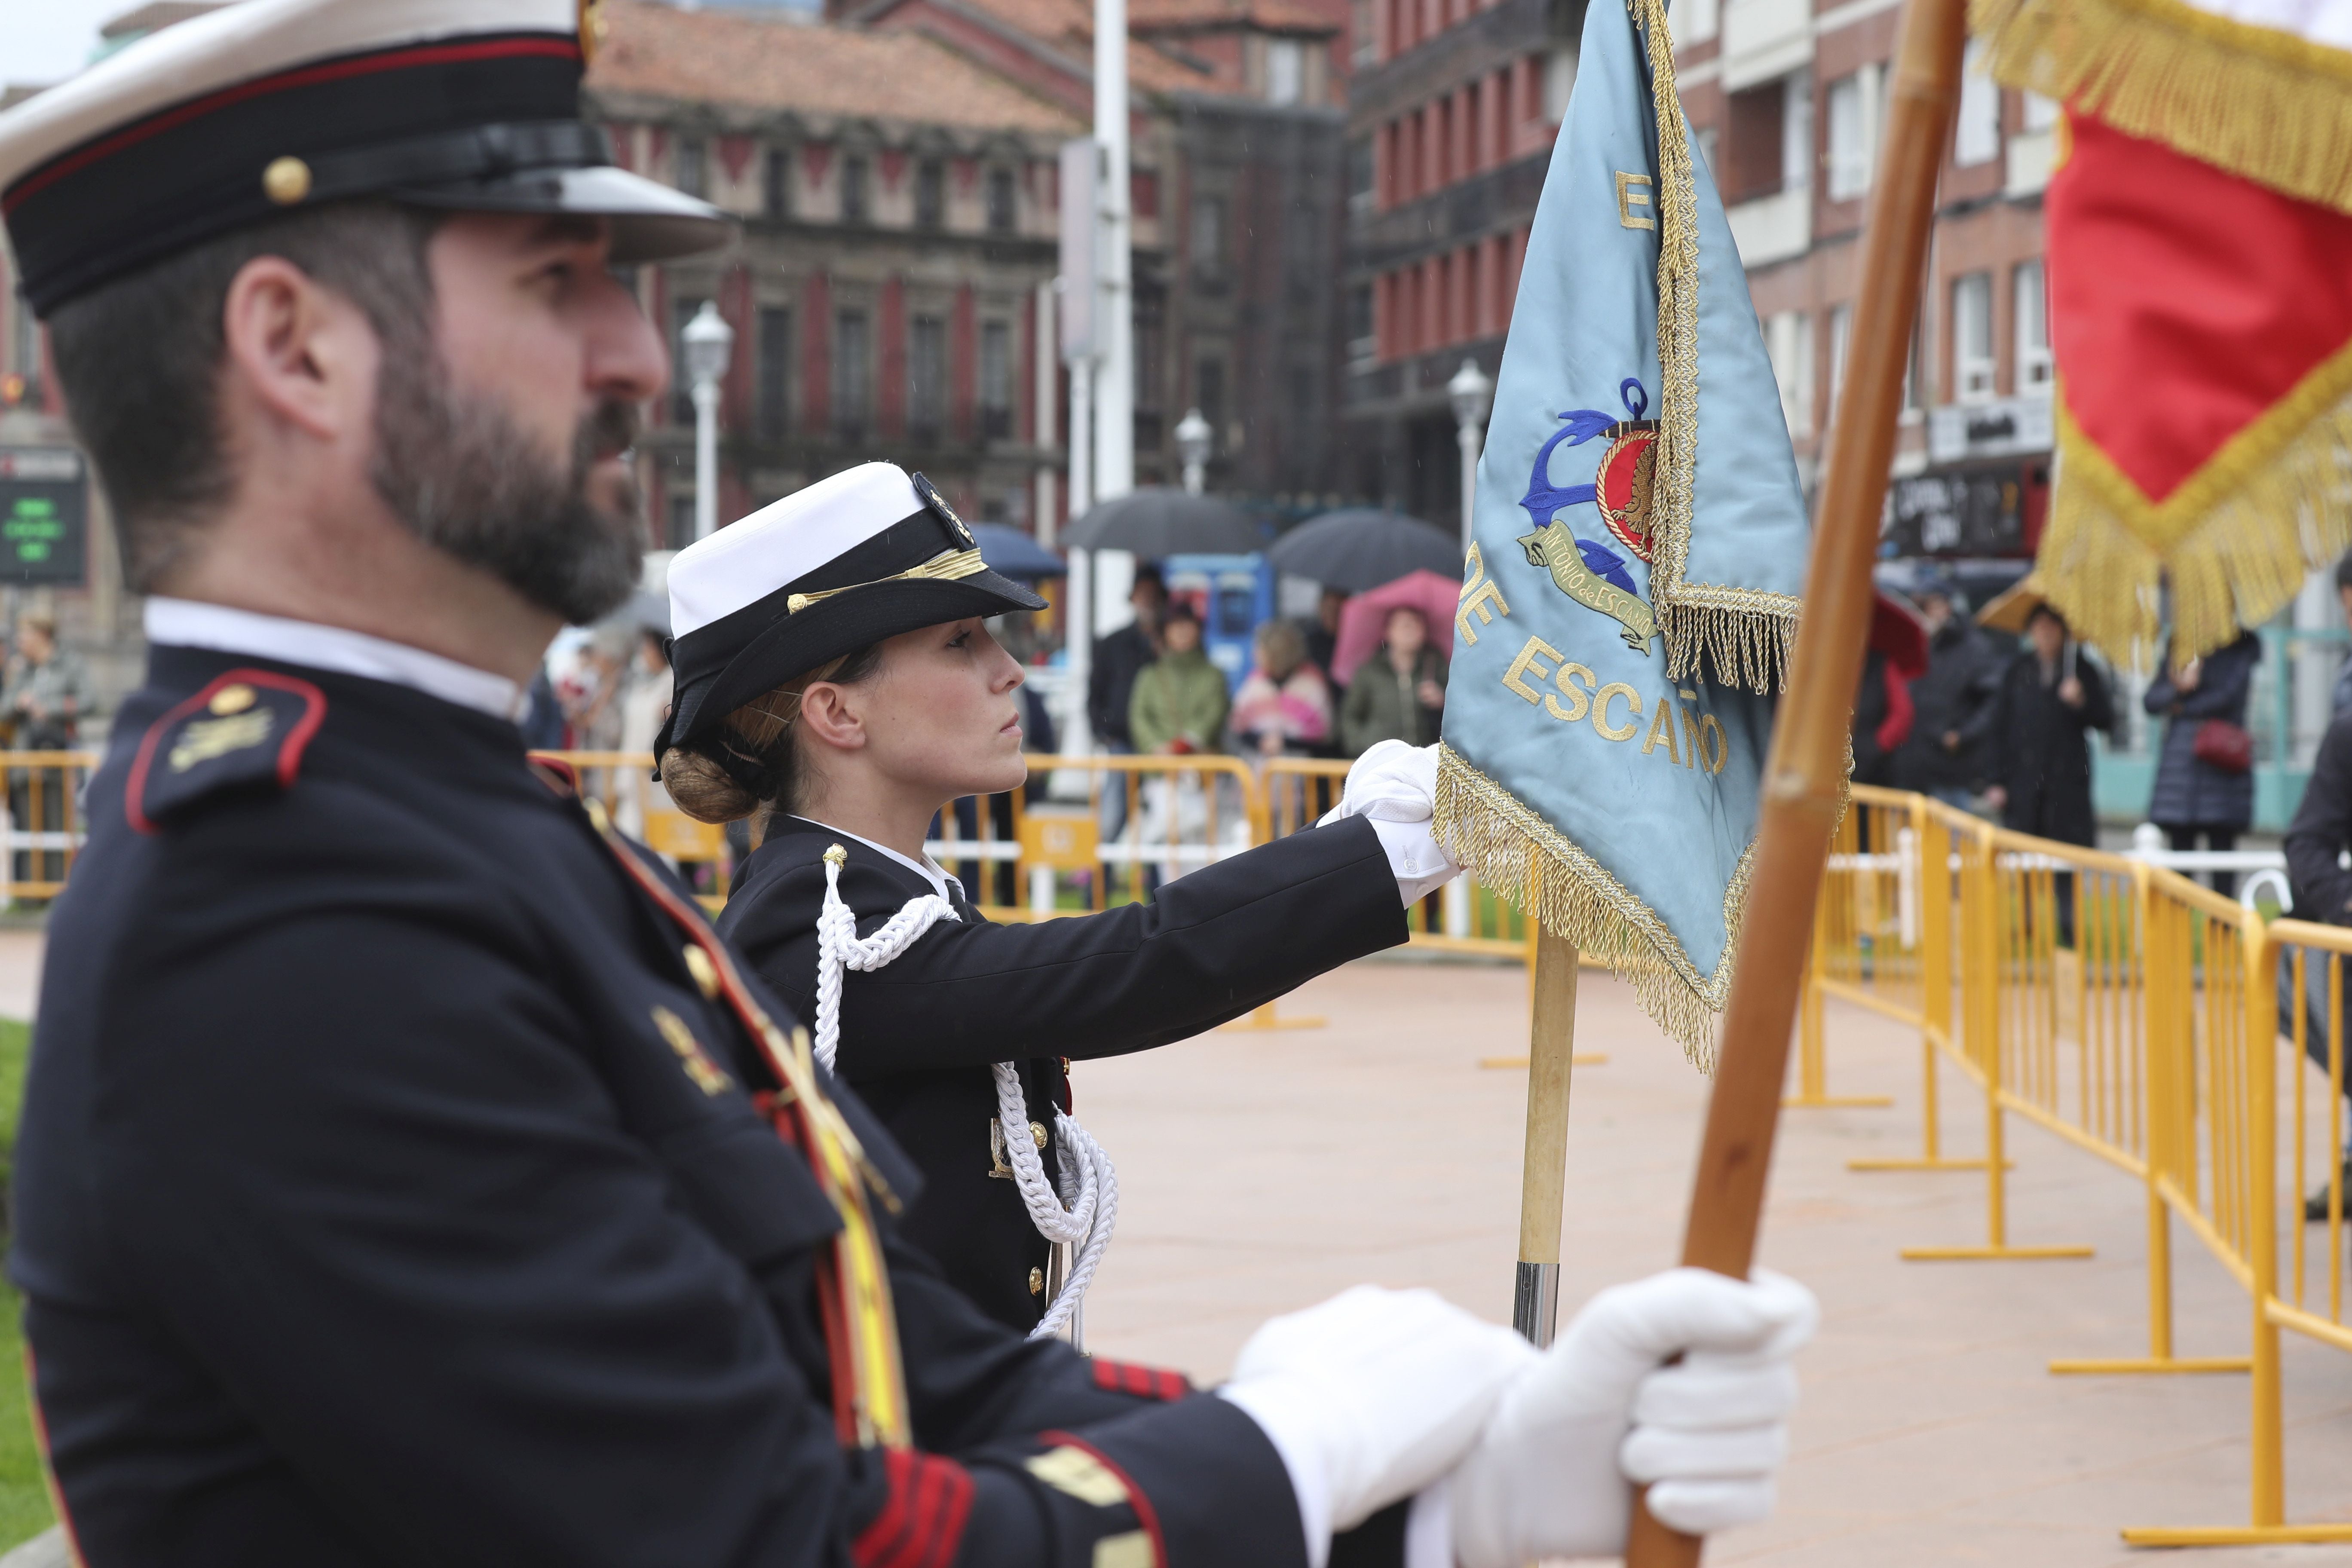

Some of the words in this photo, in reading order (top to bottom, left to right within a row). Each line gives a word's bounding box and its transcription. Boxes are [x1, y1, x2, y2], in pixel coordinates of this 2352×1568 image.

[1615, 170, 1659, 230] E
[1542, 526, 1585, 589] ANTONIO
[1578, 585, 1595, 602] de
[1594, 586, 1652, 635] ESCAÑO
[1455, 540, 1510, 647] DE
[1502, 635, 1728, 775] ESCAÑO
